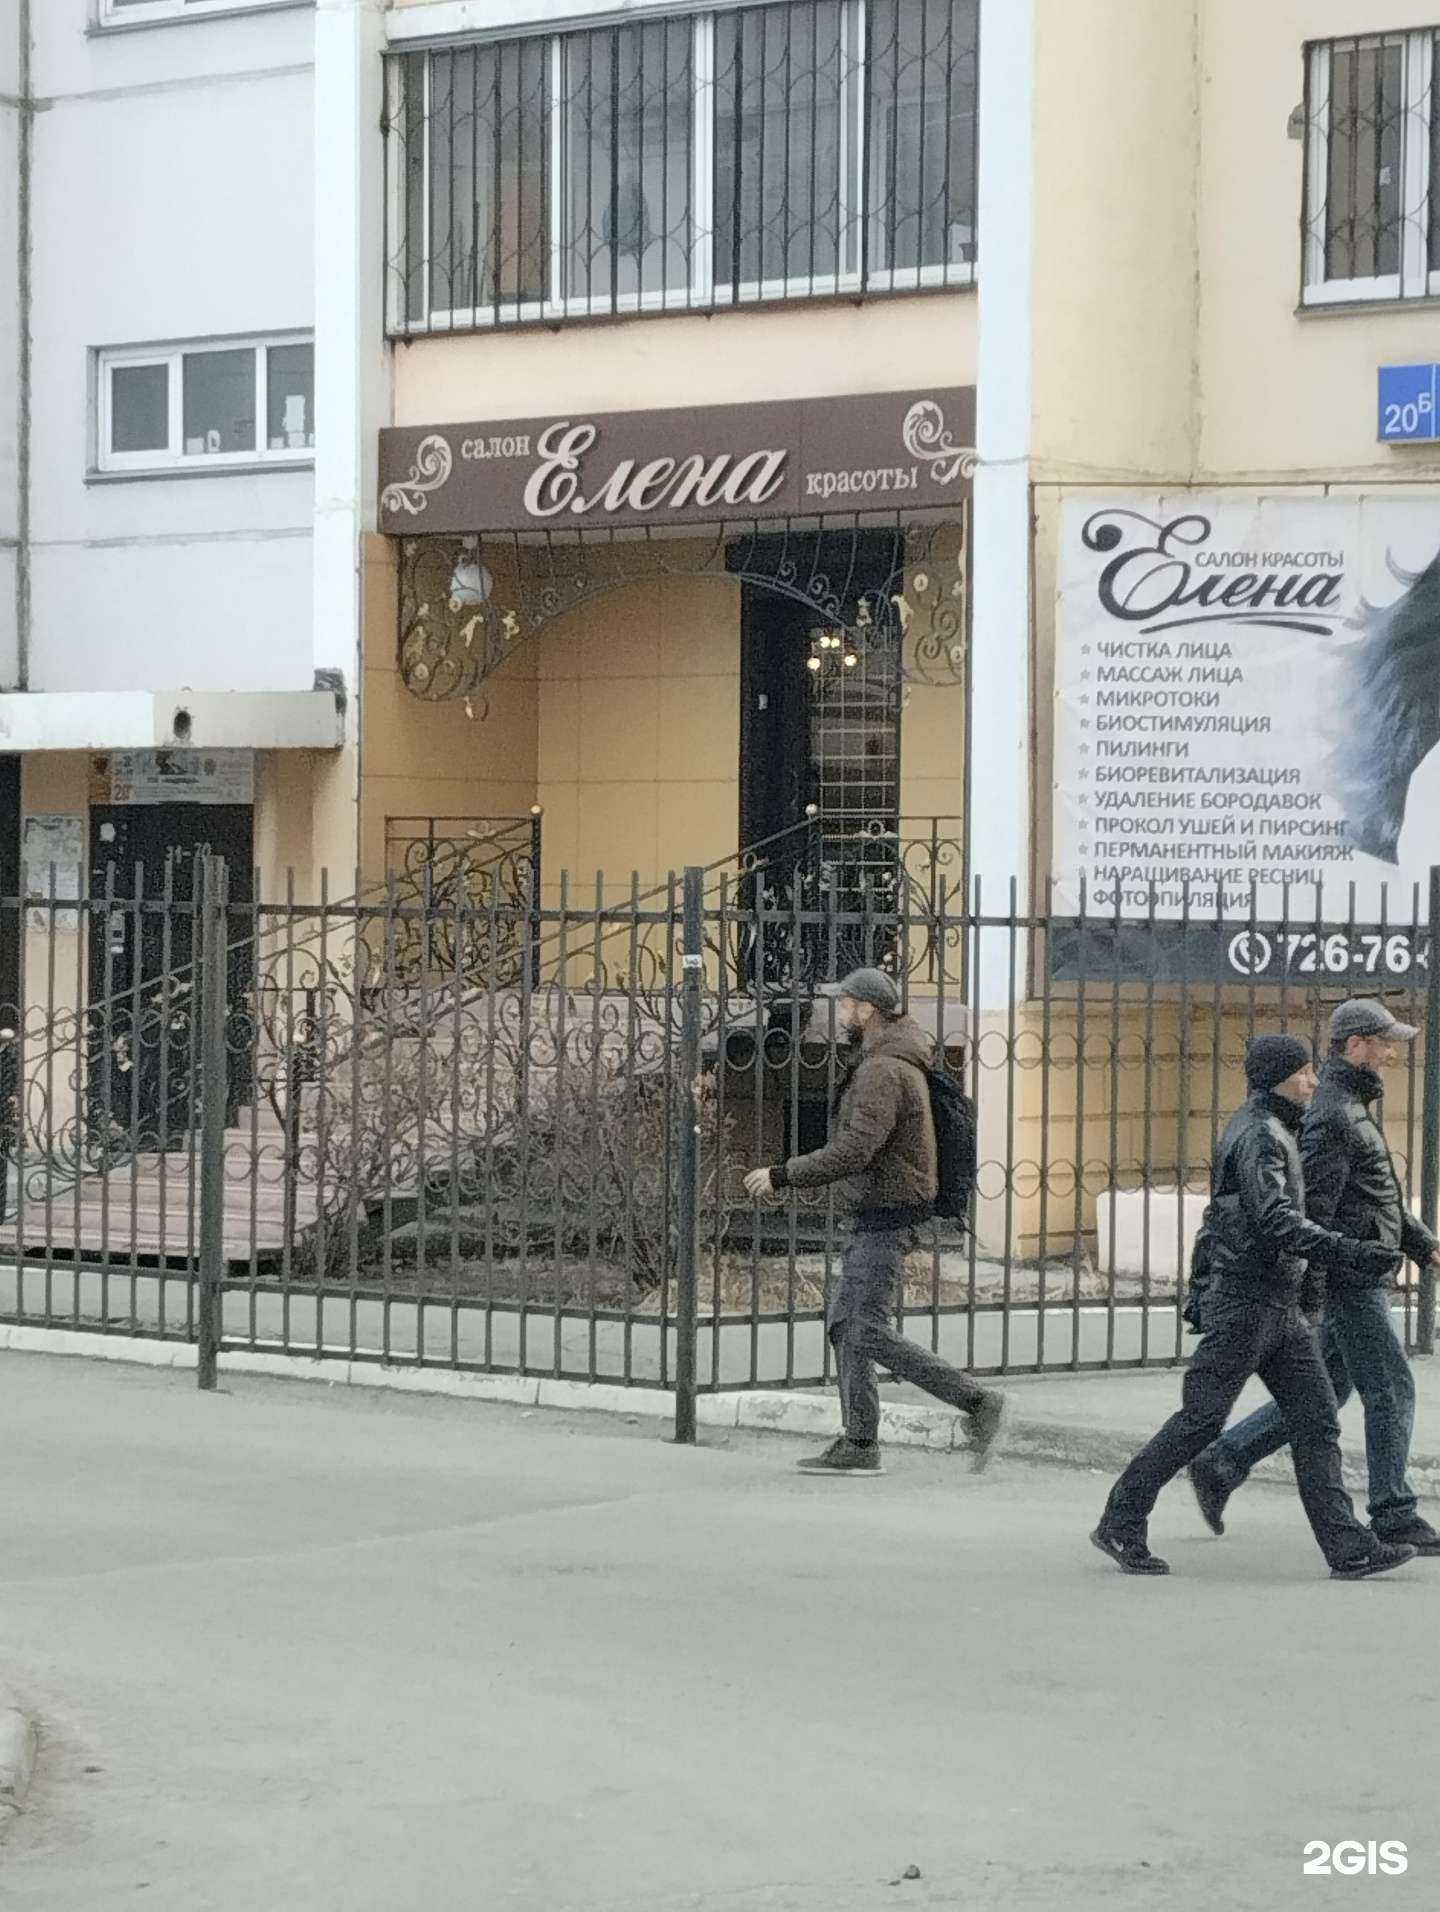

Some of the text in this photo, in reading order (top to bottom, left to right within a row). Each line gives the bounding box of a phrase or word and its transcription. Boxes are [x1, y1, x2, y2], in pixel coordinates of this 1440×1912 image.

[460, 433, 530, 461] салон
[522, 420, 787, 518] Елена
[805, 464, 918, 500] красоты
[1081, 508, 1345, 621] Елена
[1195, 550, 1344, 569] САЛОН КРАСОТЫ
[1096, 641, 1232, 662] ЧИСТКА ЛИЦА
[1096, 665, 1244, 687] МАССАЖ ЛИЦА
[1096, 690, 1220, 708] МИКРОТОКИ
[1096, 715, 1271, 736] БИОСТИМУЛЯЦИЯ
[1095, 740, 1189, 758] ПИЛИНГИ
[1095, 765, 1300, 787] БИОРЕВИТАЛИЗАЦИЯ
[1095, 791, 1322, 812] УДАЛЕНИЕ БОРОДАВОК
[1095, 815, 1349, 837] ПРОКОЛ УШЕЙ И ПИРСИНГ
[1094, 840, 1353, 861] ПЕРМАНЕНТНЫЙ МАКИЯЖ
[1094, 865, 1323, 889] НАРАЩИВАНИЕ РЕСНИЦ
